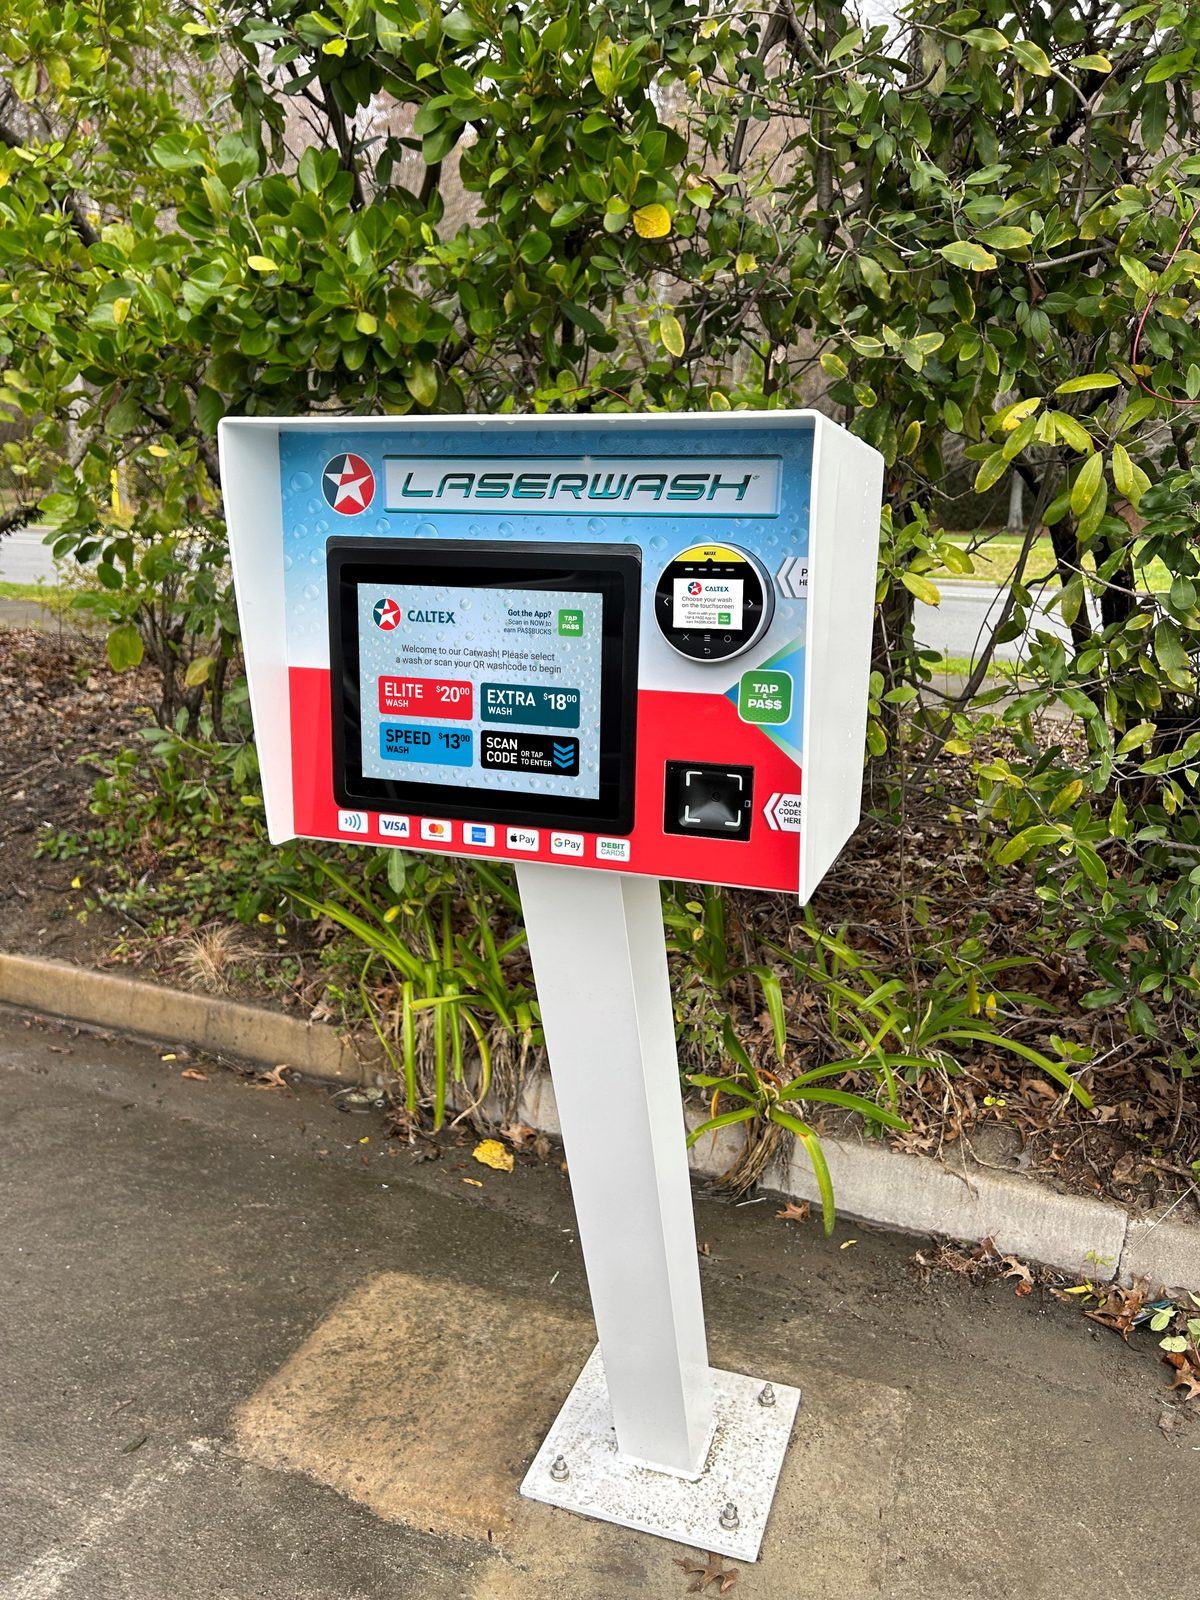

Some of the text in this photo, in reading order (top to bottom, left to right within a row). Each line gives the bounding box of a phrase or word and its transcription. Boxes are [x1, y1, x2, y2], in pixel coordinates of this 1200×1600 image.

[401, 472, 753, 501] LASERWASH
[407, 610, 456, 624] CALTEX
[507, 608, 552, 619] Got the App?
[402, 644, 555, 661] Welcome to our Carwash! Please select
[402, 656, 423, 665] wash
[454, 660, 471, 669] your
[473, 660, 484, 669] QR
[486, 661, 527, 671] washcode
[529, 664, 537, 672] to
[540, 663, 562, 674] begin
[384, 682, 424, 699] ELITE
[752, 683, 779, 694] TAP
[385, 698, 409, 708] WASH
[487, 689, 536, 706] EXTRA
[488, 706, 513, 716] WASH
[386, 728, 431, 746] SPEED
[486, 736, 518, 750] SCAN
[386, 745, 409, 754] WASH
[486, 750, 518, 764] CODE
[530, 759, 552, 767] ENTER
[383, 820, 408, 832] VISA
[519, 834, 536, 846] Pay
[564, 839, 581, 851] Pay
[601, 841, 626, 850] DEBIT
[600, 848, 626, 857] CARDS
